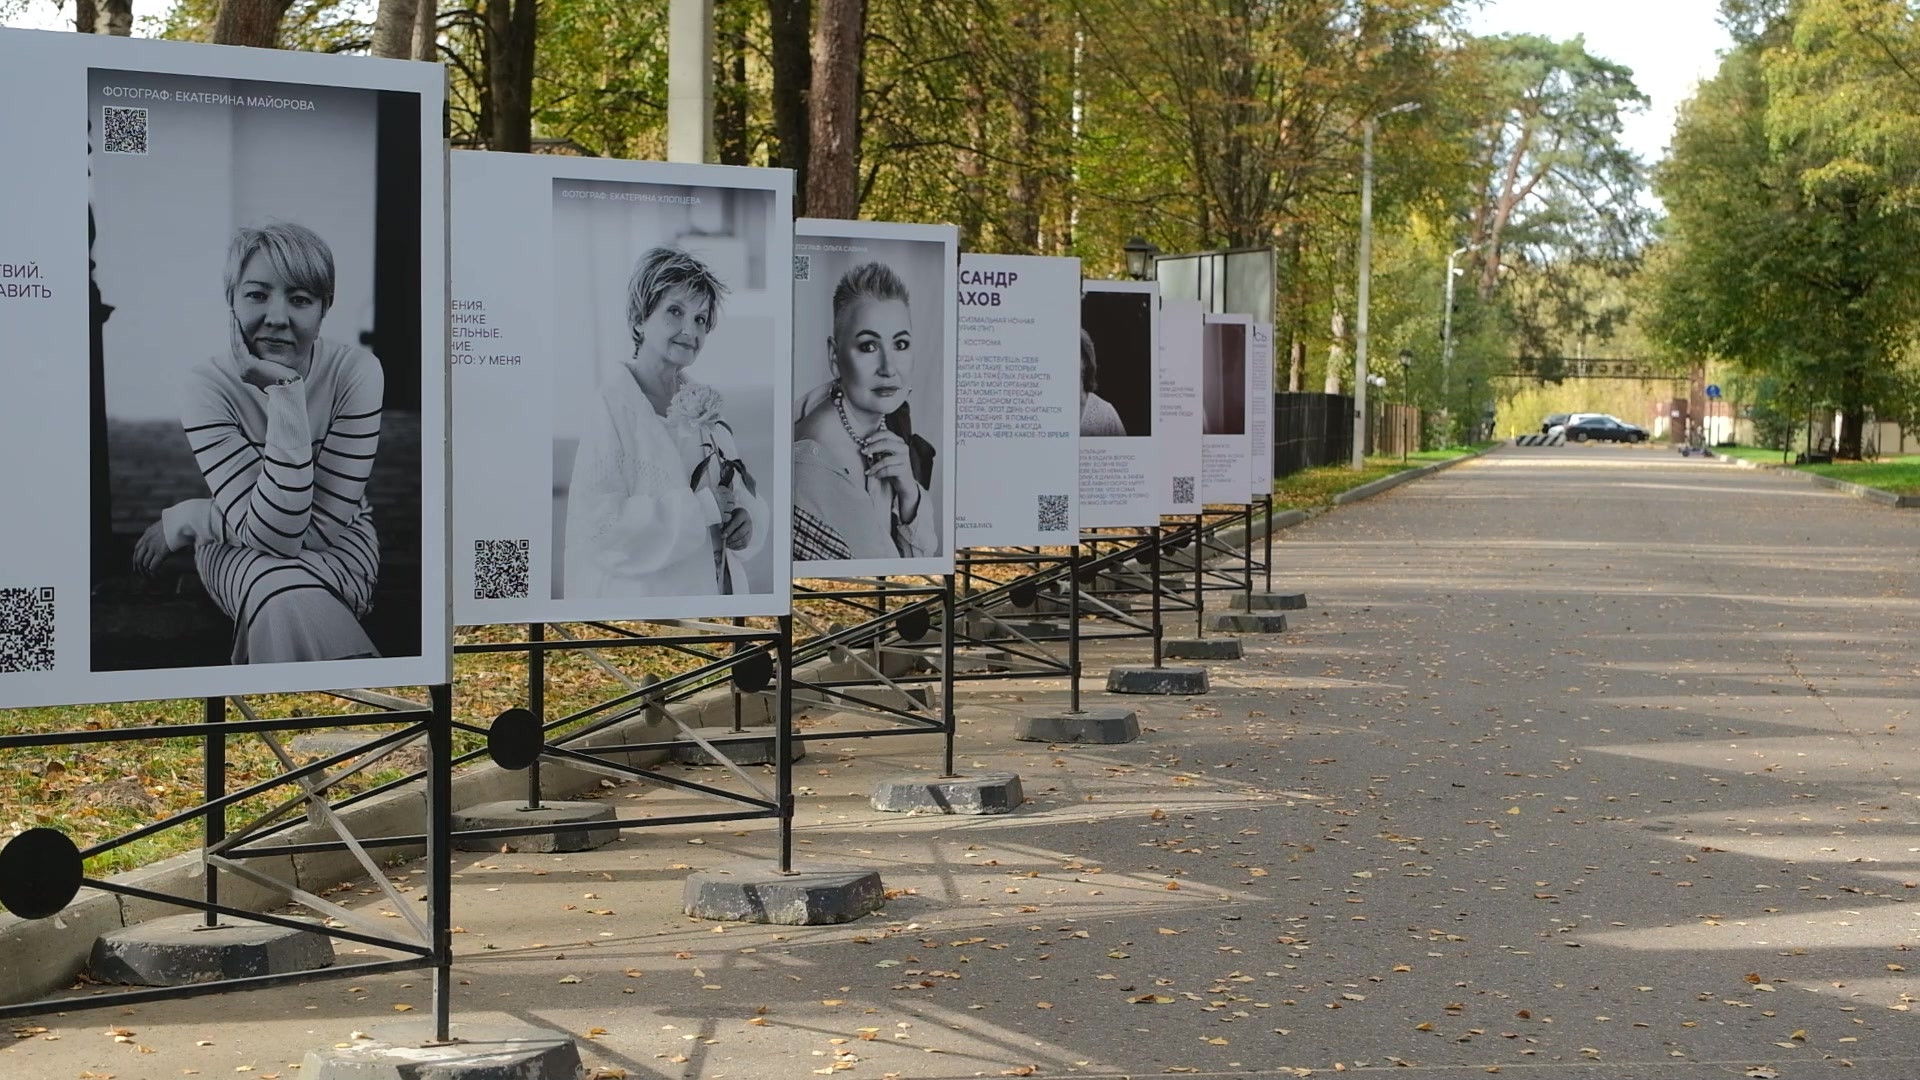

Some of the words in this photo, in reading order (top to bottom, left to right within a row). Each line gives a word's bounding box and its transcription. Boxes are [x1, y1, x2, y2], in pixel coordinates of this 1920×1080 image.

[102, 86, 173, 101] ФОТОГРАФ:
[175, 91, 245, 106] ЕКАТЕРИНА
[247, 95, 315, 111] МАЙОРОВА
[610, 192, 657, 202] ЕКАТЕРИНА
[657, 195, 701, 205] ХЛОПЦЕВА
[0, 261, 44, 279] ВИЙ.
[958, 270, 1018, 289] САНДР
[478, 355, 487, 365] У
[489, 355, 521, 366] МЕНЯ
[1003, 390, 1043, 398] ПЕРЕСАДКИ
[976, 398, 1012, 406] ДОНОРОМ
